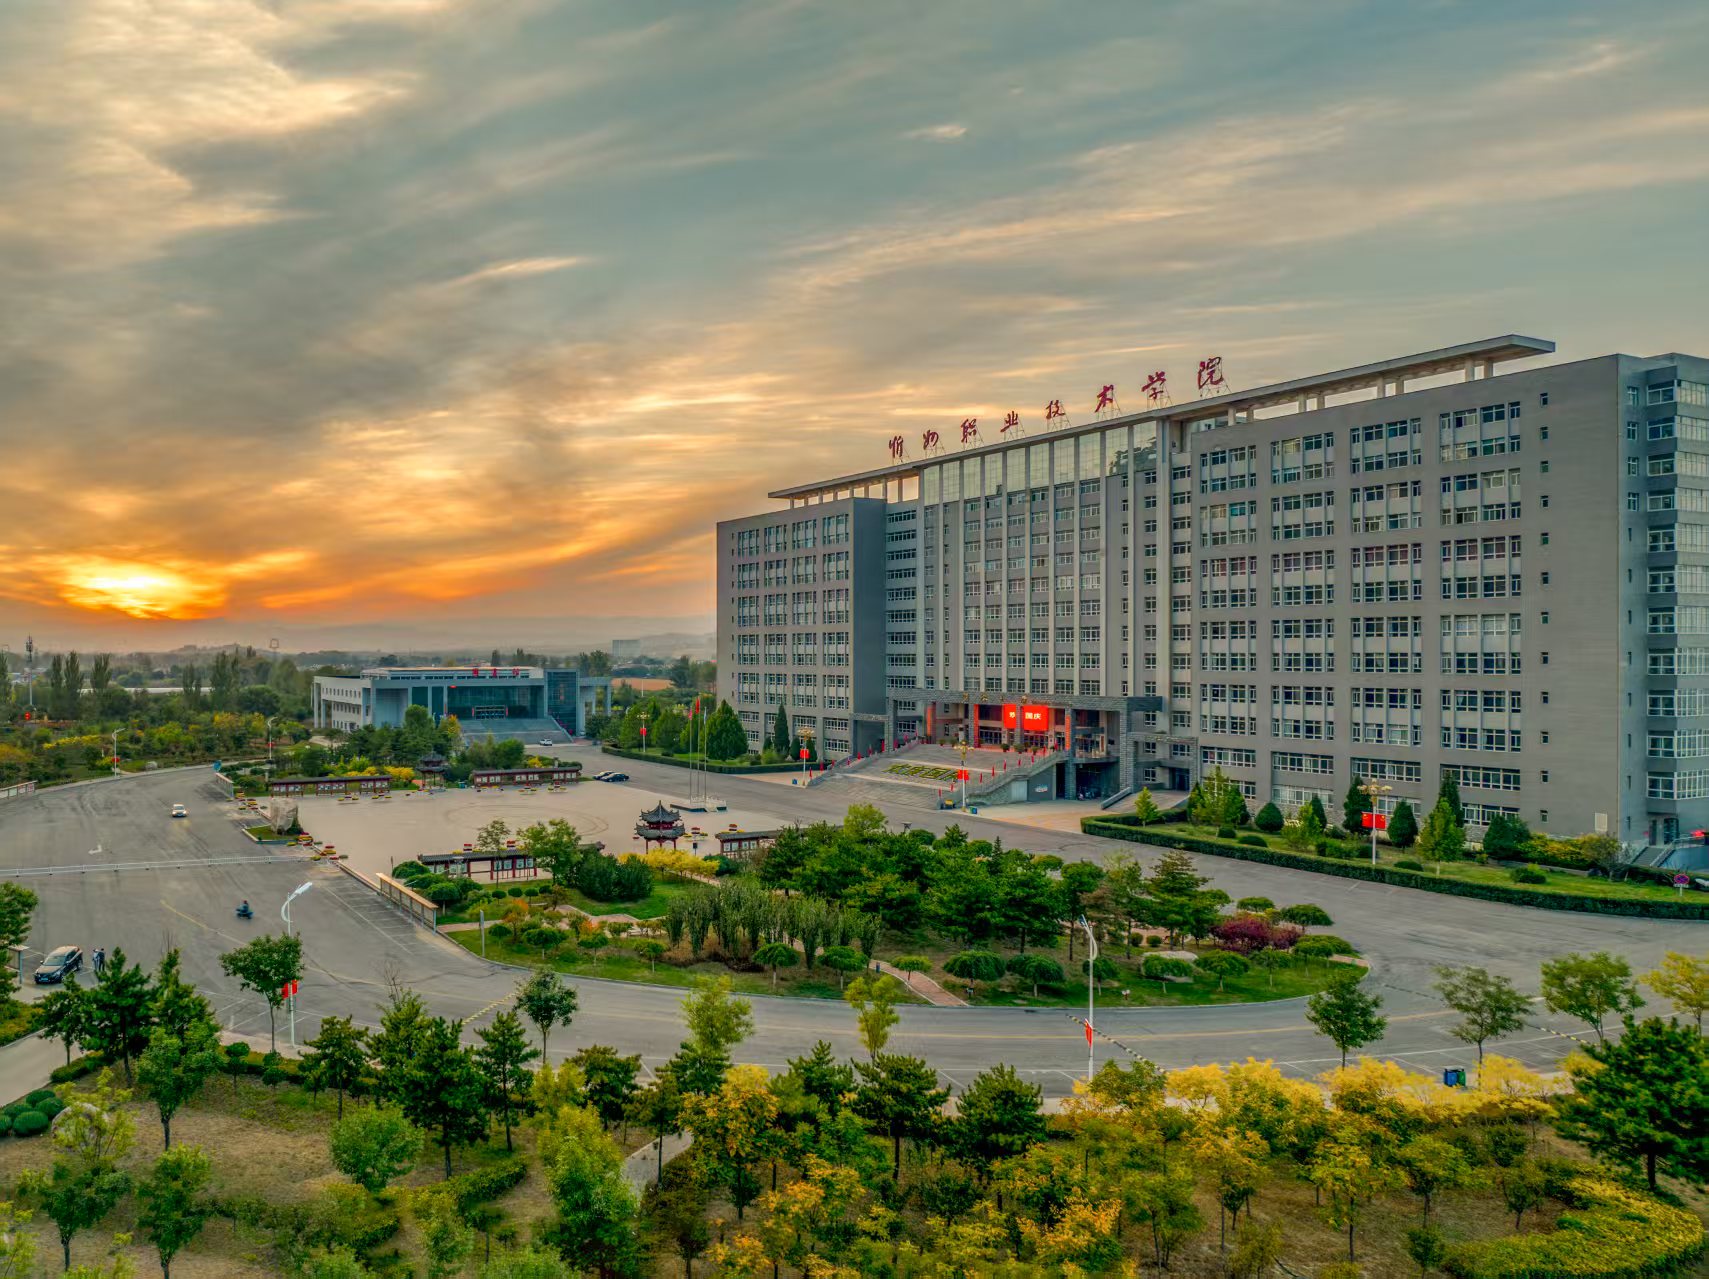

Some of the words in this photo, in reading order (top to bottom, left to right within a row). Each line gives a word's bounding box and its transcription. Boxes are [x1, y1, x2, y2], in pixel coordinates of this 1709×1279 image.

[889, 356, 1224, 458] 忻州职业技术学院
